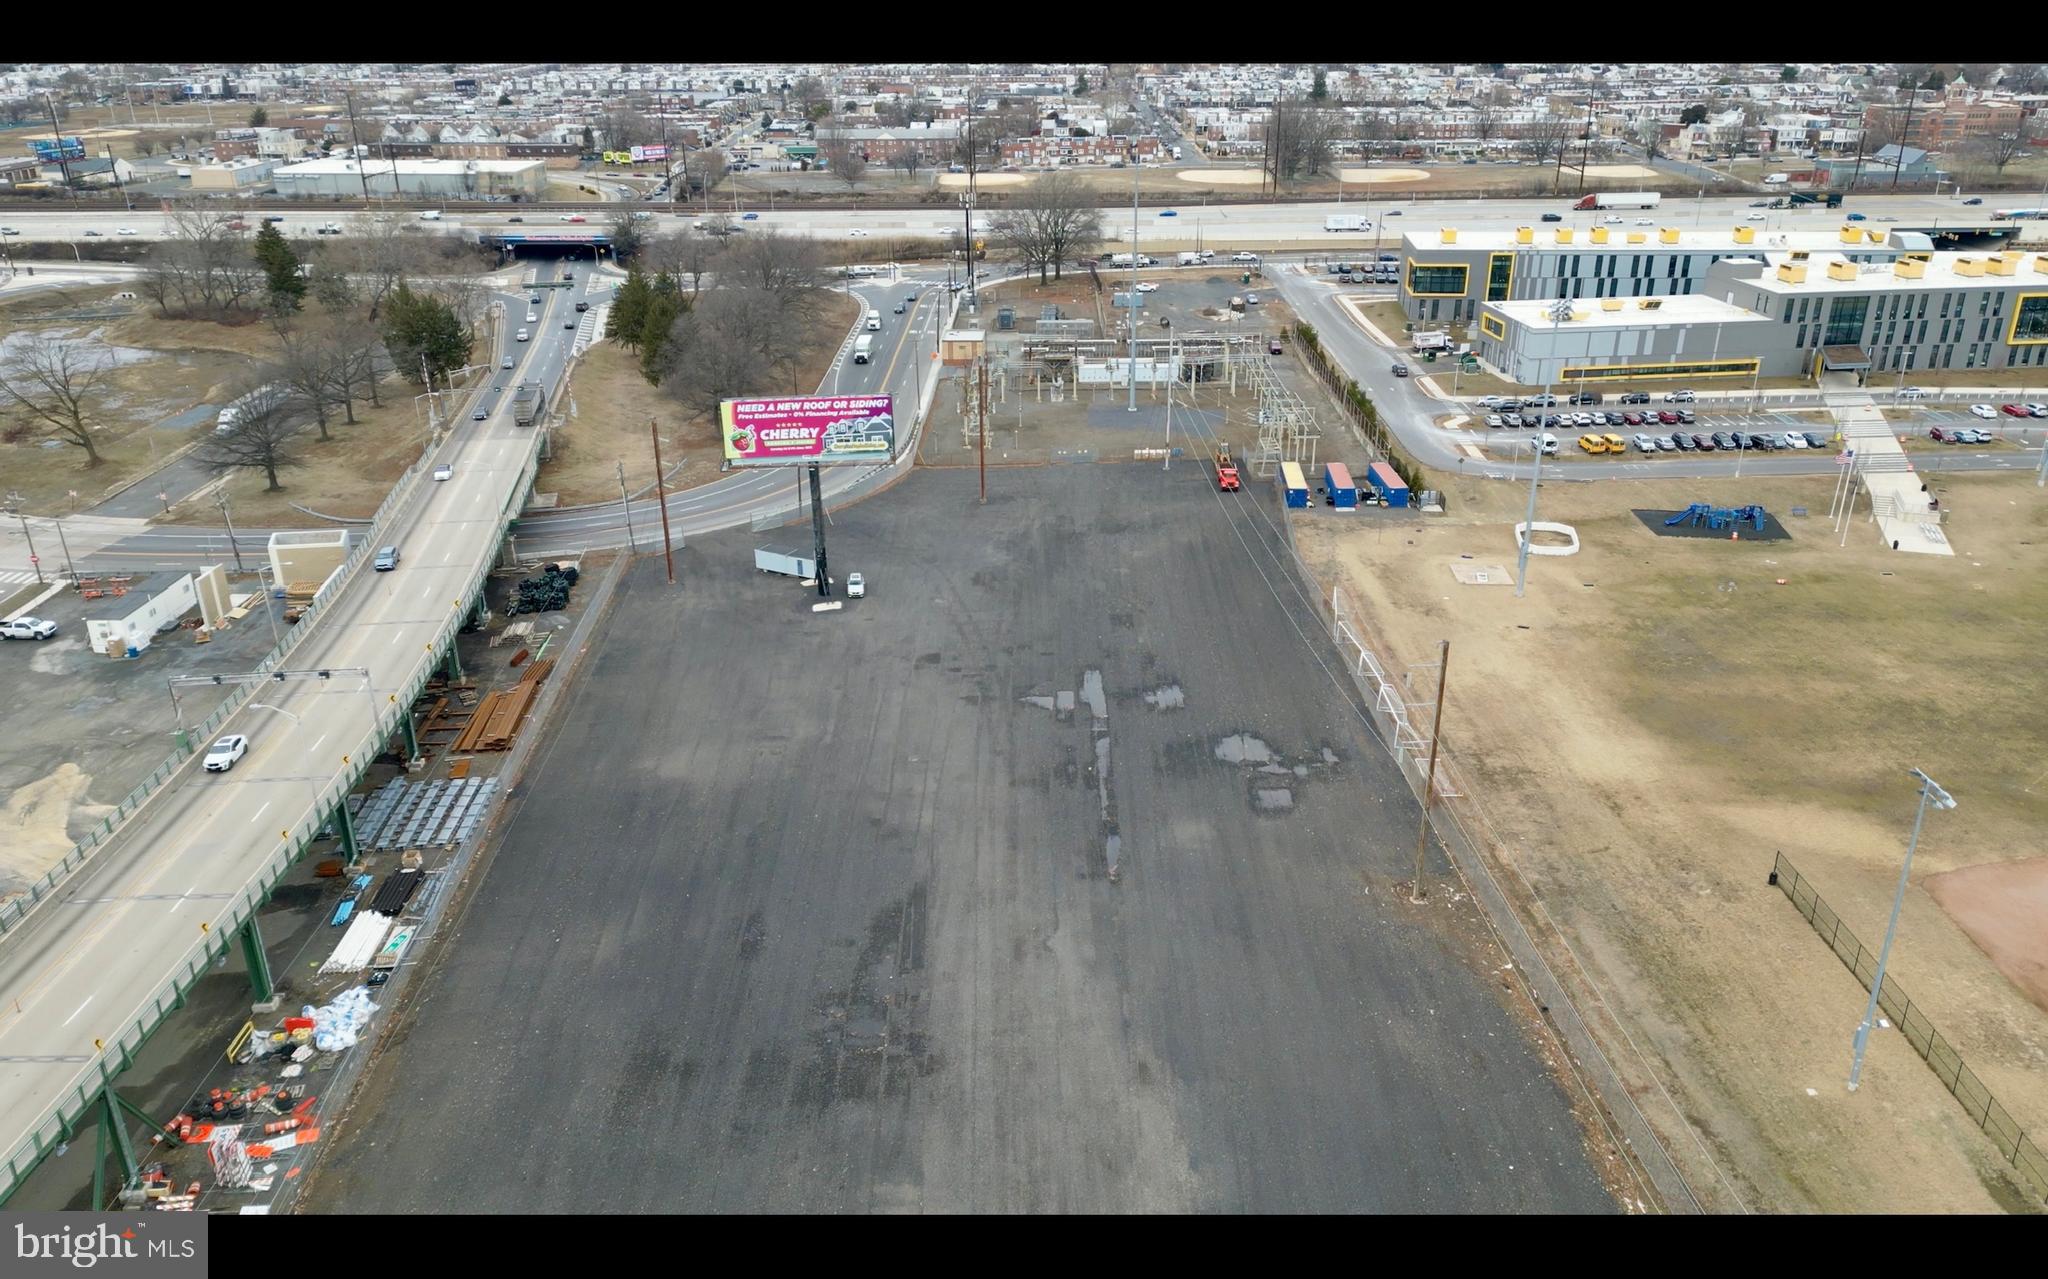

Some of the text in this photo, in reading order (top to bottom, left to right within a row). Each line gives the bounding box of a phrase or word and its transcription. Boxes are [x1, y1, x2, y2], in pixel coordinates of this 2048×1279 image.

[737, 399, 889, 412] NEED A NEW ROOF OR SIDING?
[760, 427, 819, 439] CHERRY
